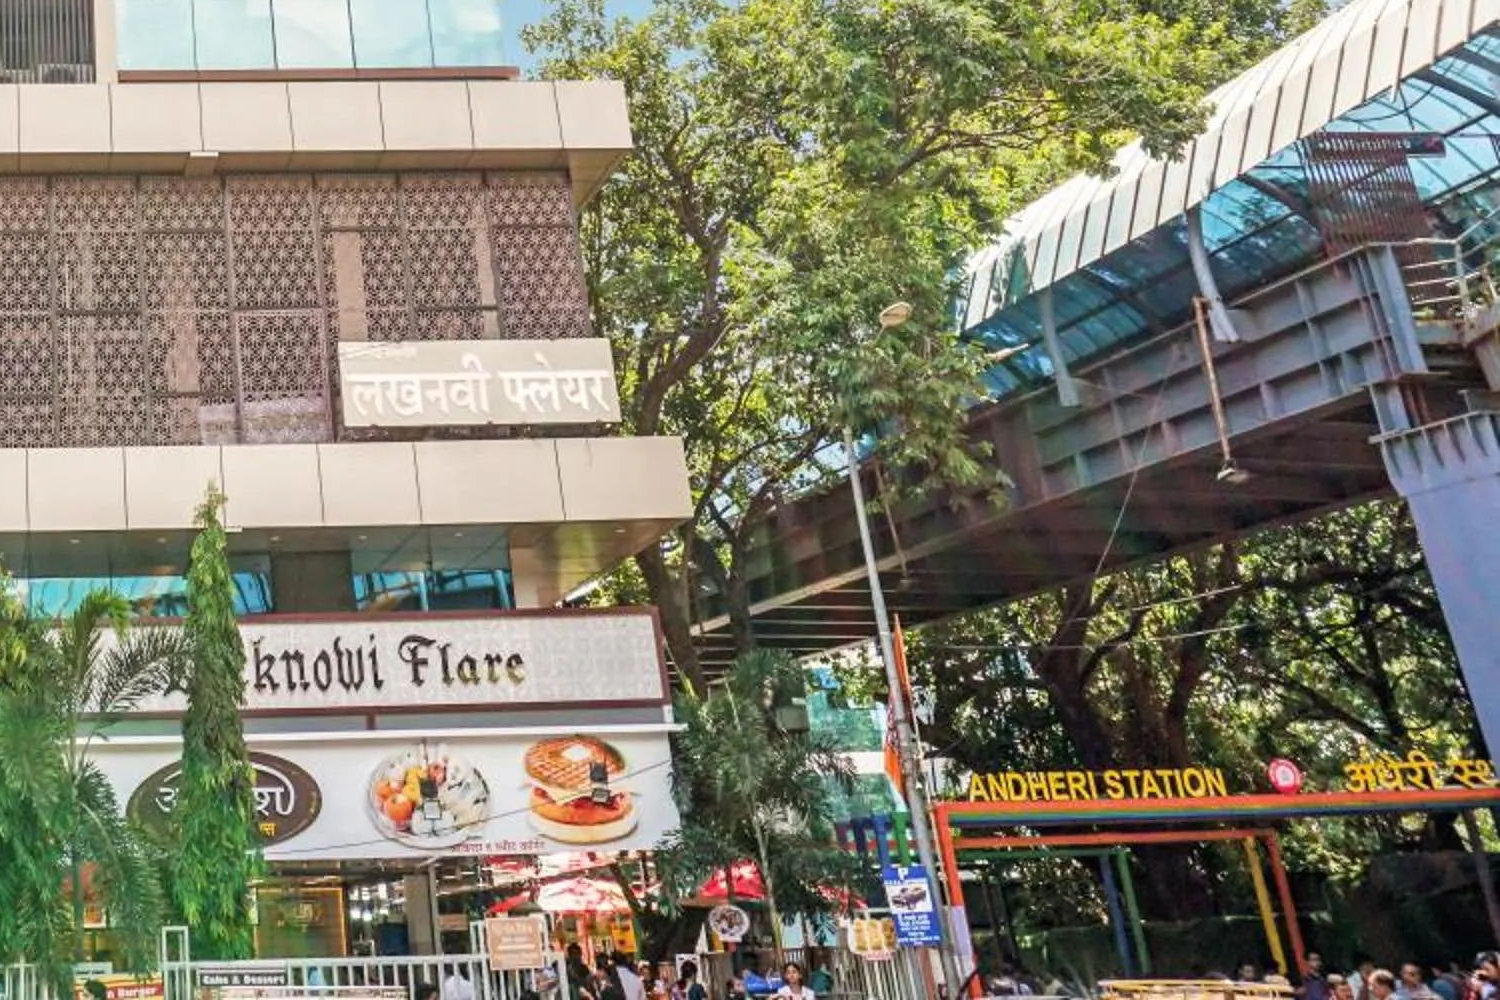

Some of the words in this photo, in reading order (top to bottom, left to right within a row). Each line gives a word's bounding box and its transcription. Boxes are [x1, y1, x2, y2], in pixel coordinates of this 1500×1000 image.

[251, 634, 384, 692] knowi
[399, 634, 526, 688] Flare
[968, 770, 1098, 802] ANDHERI
[1104, 767, 1227, 799] STATION
